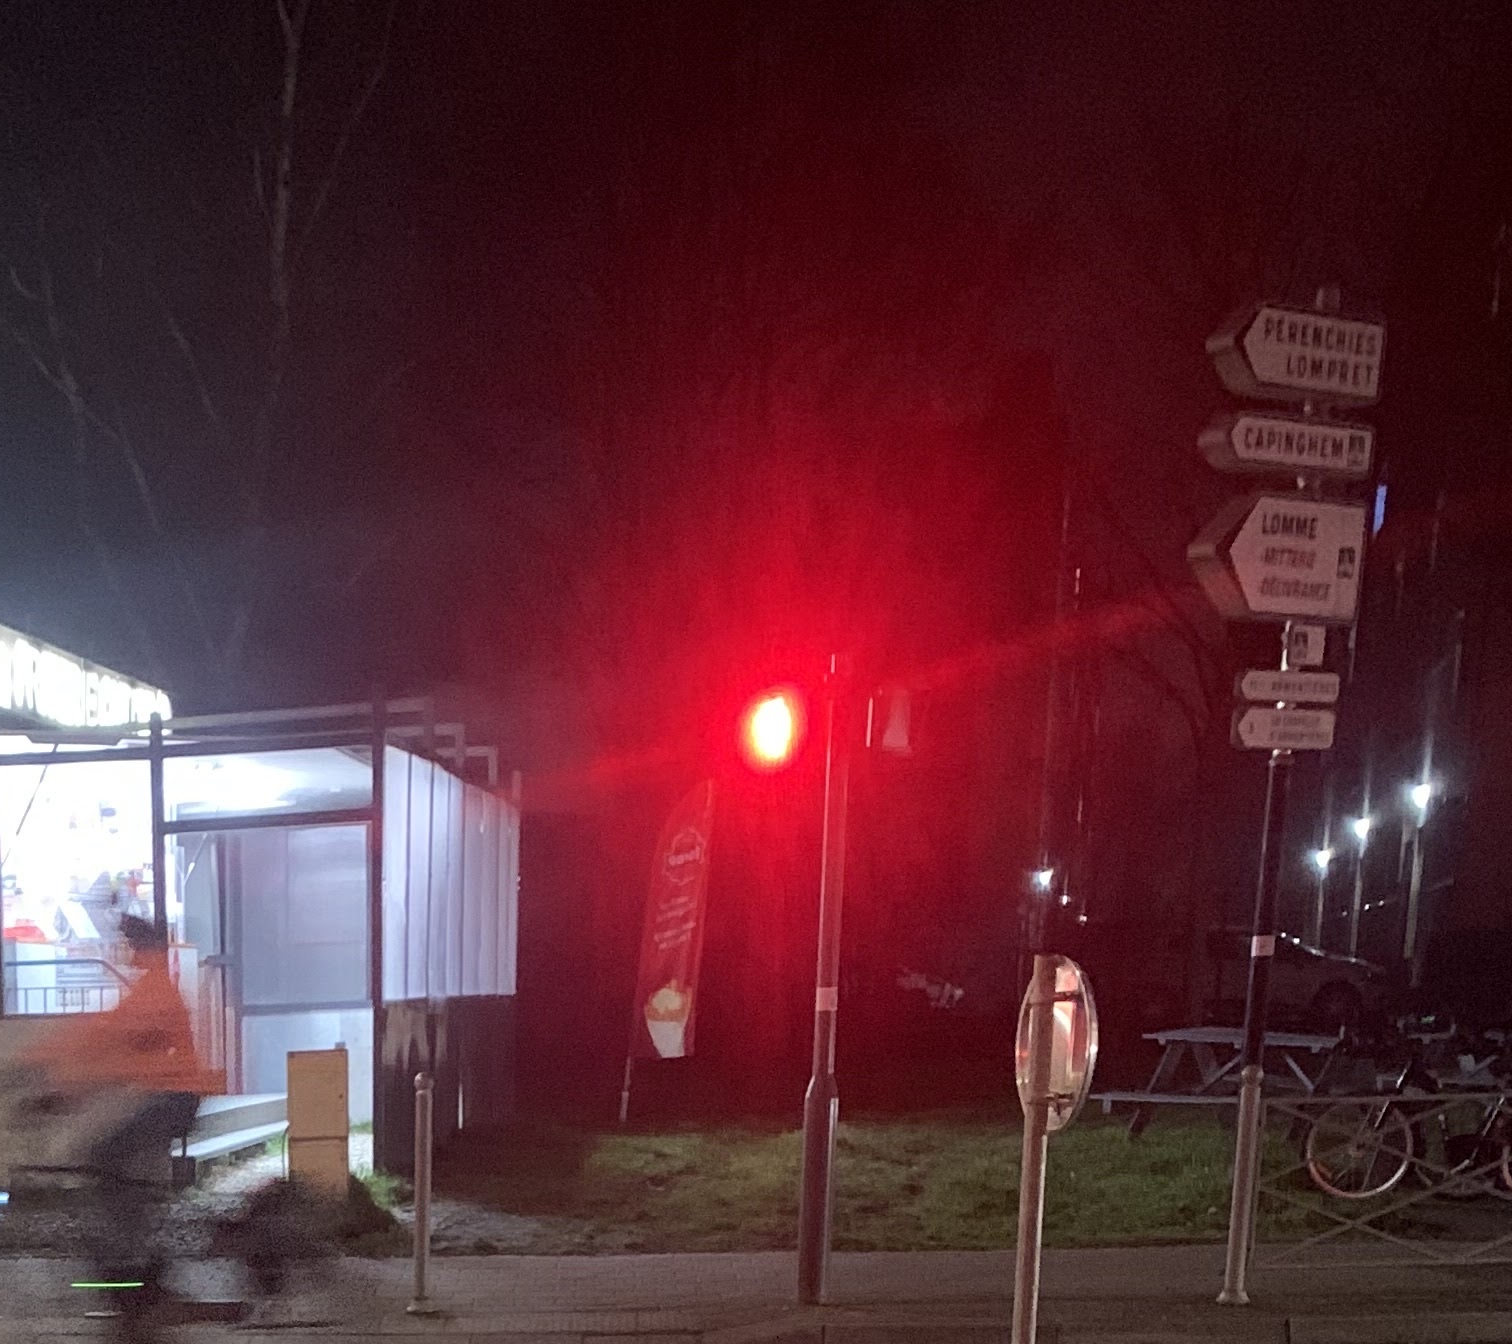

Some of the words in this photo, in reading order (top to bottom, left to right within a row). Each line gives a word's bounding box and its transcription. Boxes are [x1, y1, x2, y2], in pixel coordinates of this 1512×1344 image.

[1286, 353, 1374, 387] LOMPRET
[1243, 426, 1335, 458] CAPINGHEM
[1262, 512, 1319, 541] LOMME
